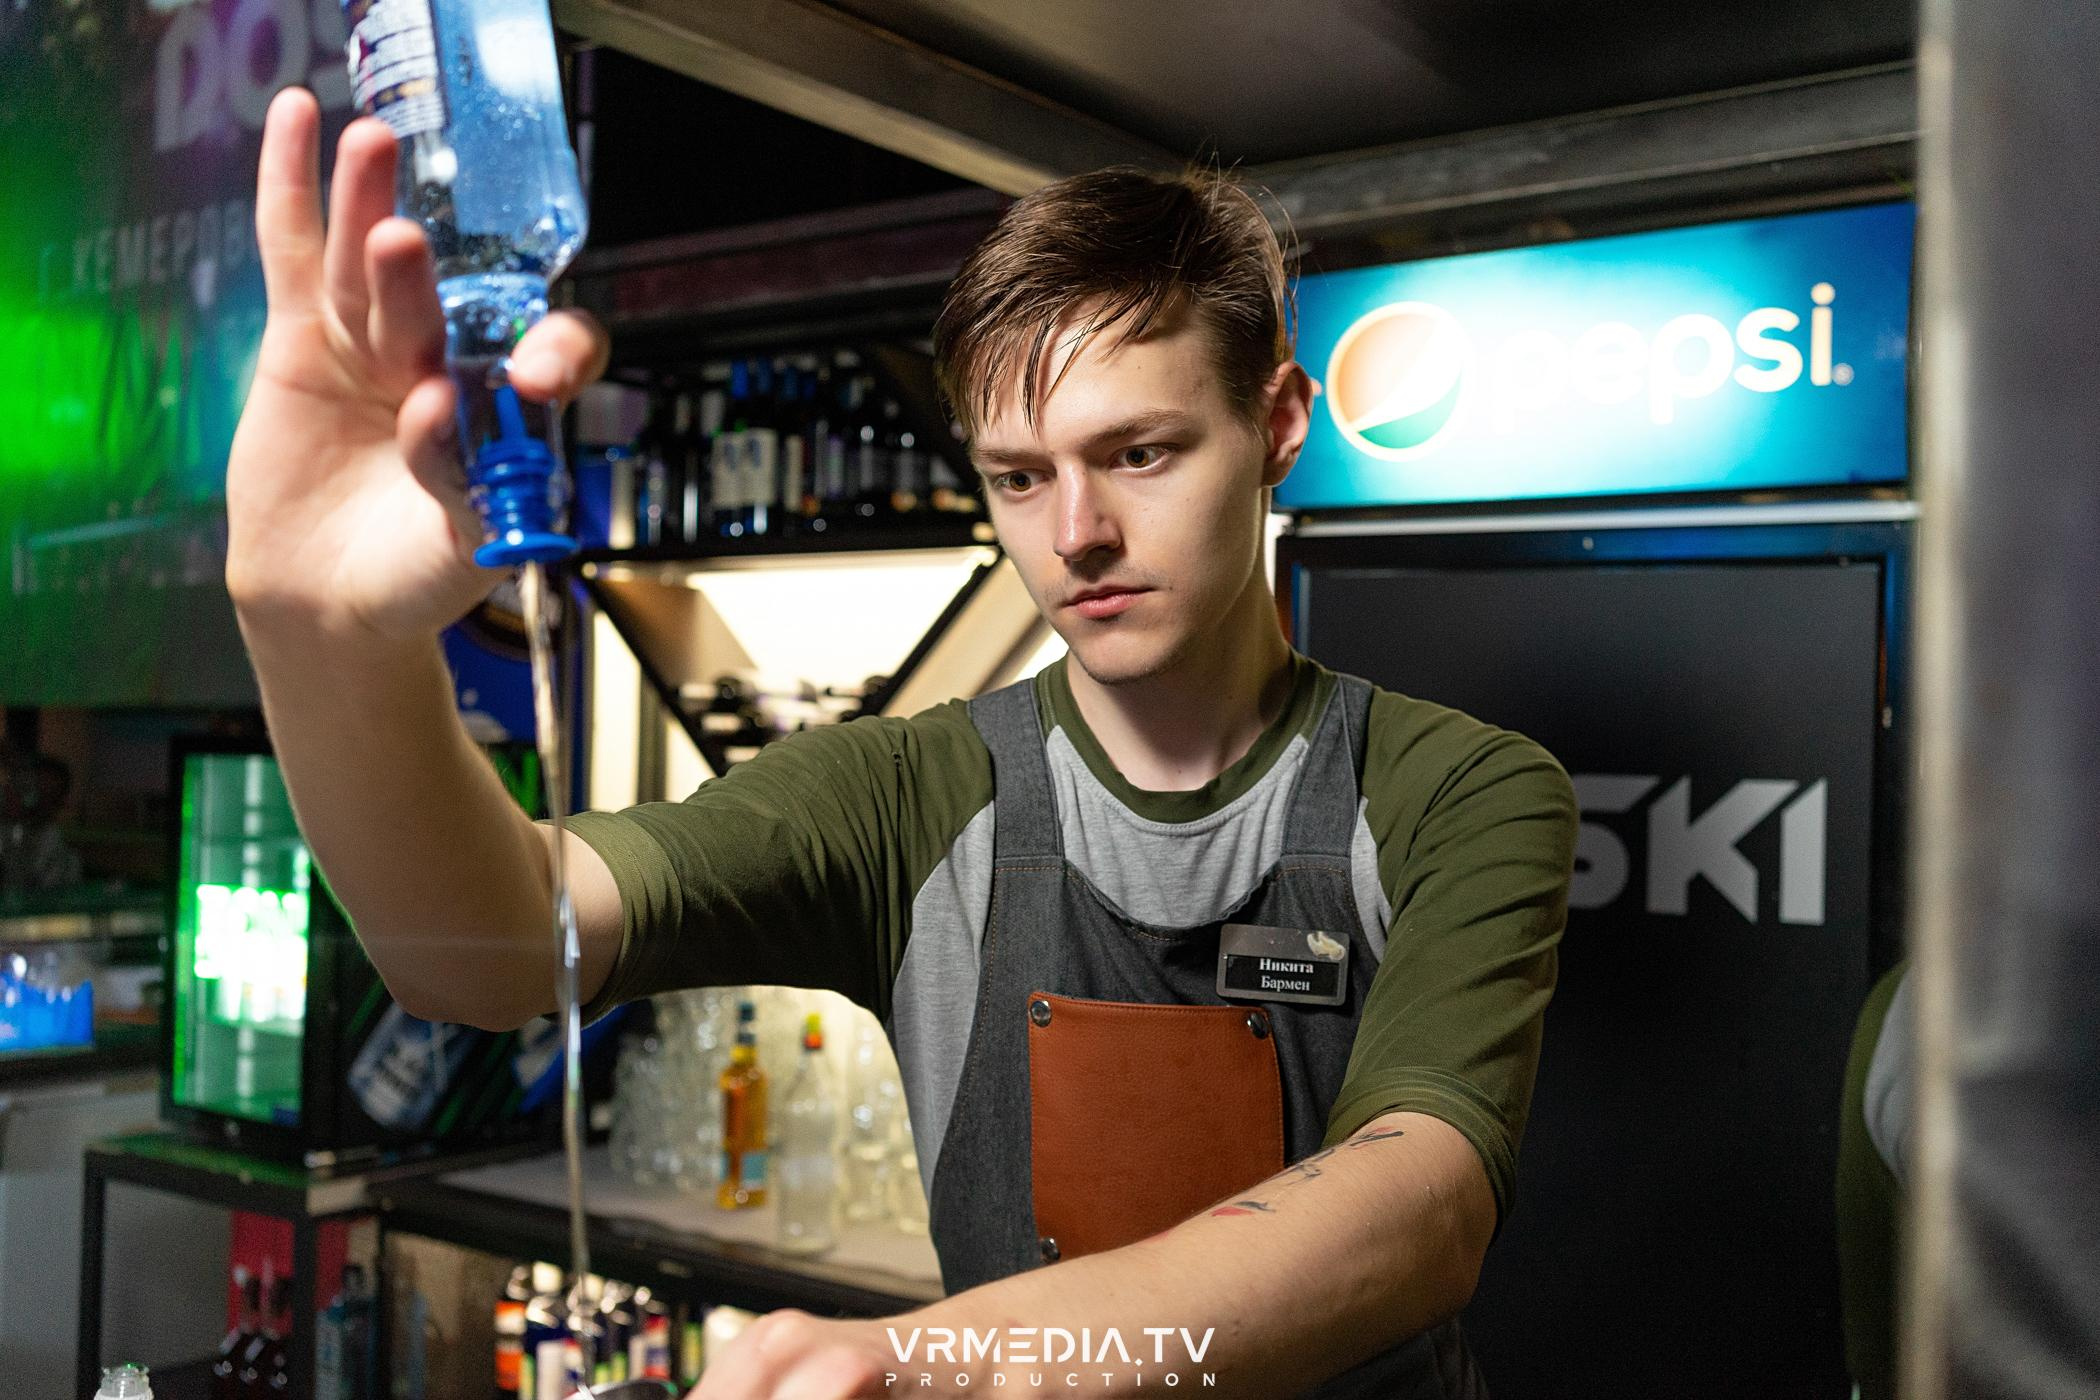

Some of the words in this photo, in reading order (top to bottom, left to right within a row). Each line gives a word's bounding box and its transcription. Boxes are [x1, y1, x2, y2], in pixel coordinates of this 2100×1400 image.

[1493, 281, 1836, 436] pepsi
[1259, 957, 1314, 974] Никита
[1260, 975, 1311, 993] Бармен
